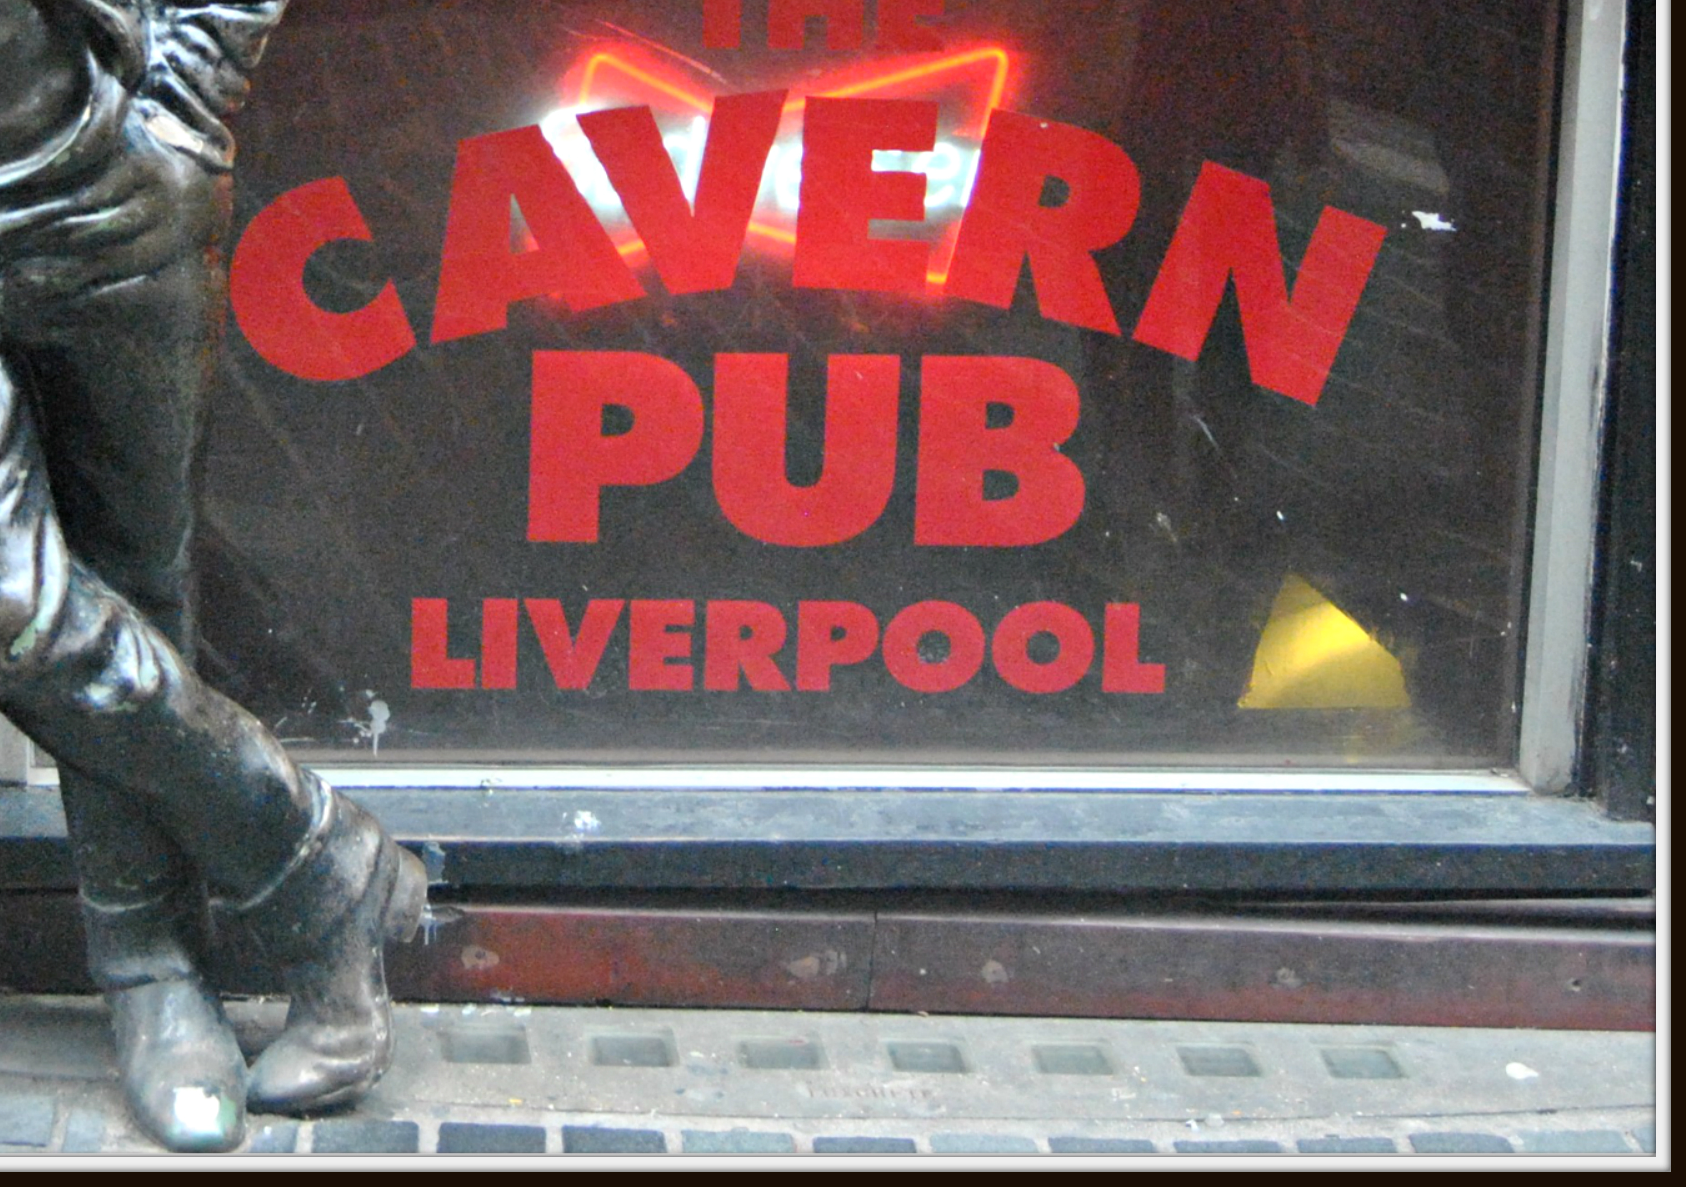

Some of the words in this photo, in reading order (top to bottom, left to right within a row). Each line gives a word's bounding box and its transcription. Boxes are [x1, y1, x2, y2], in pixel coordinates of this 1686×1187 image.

[229, 89, 1387, 408] CAVERN
[528, 349, 1086, 547] PUB
[412, 598, 1166, 694] LIVERPOOL
